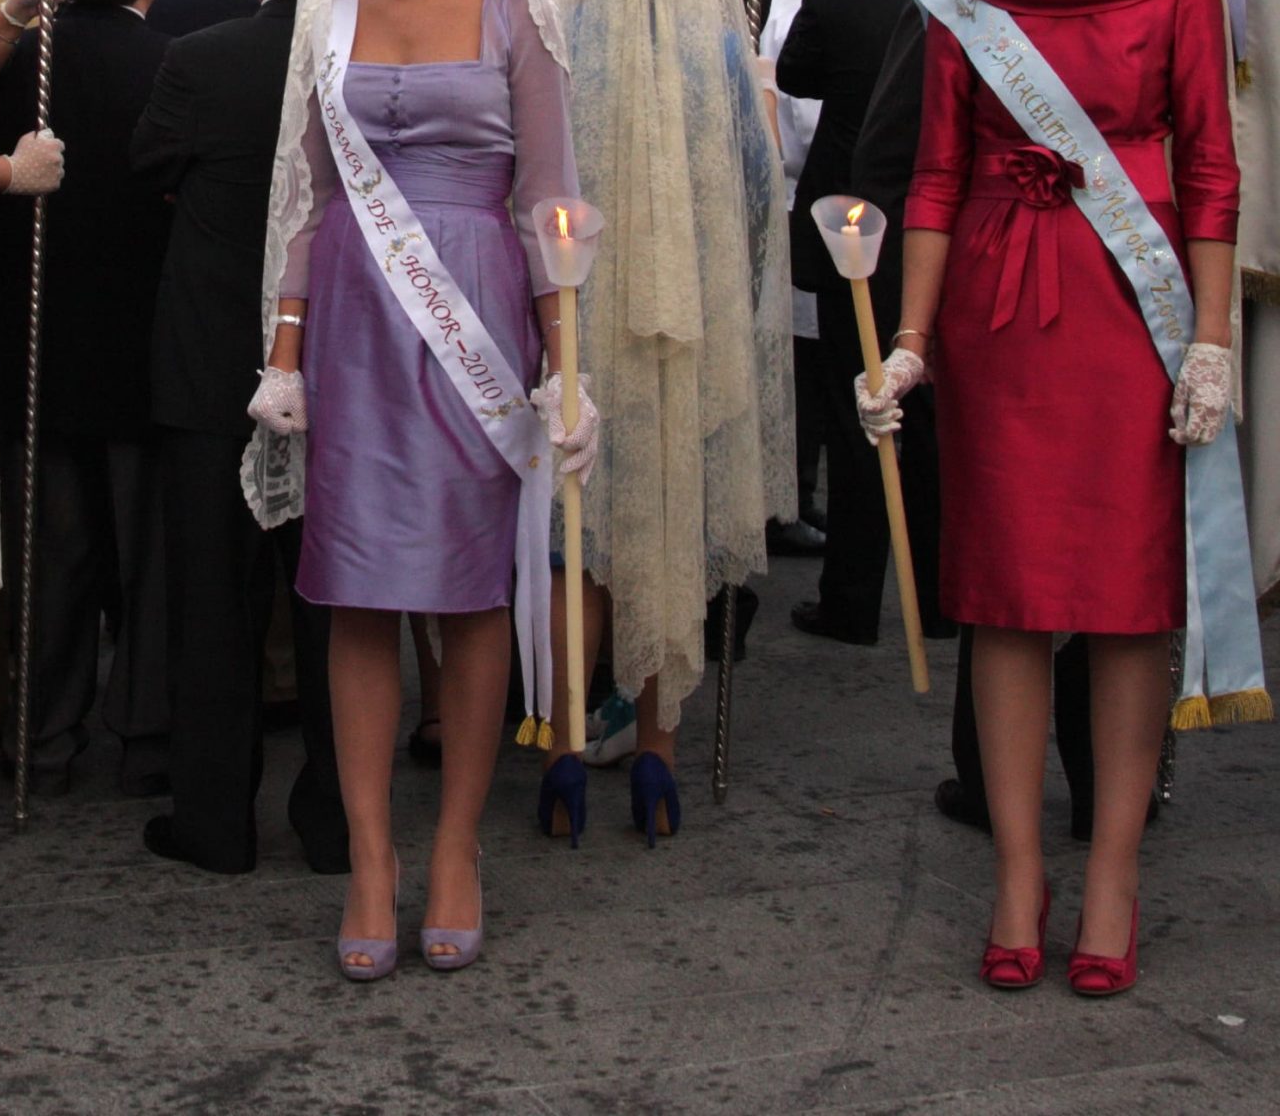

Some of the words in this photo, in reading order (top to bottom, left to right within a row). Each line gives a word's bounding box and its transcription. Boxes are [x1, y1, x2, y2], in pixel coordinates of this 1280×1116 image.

[324, 101, 364, 178] DAMA
[366, 198, 397, 236] DE
[1091, 190, 1149, 268] MAYOR
